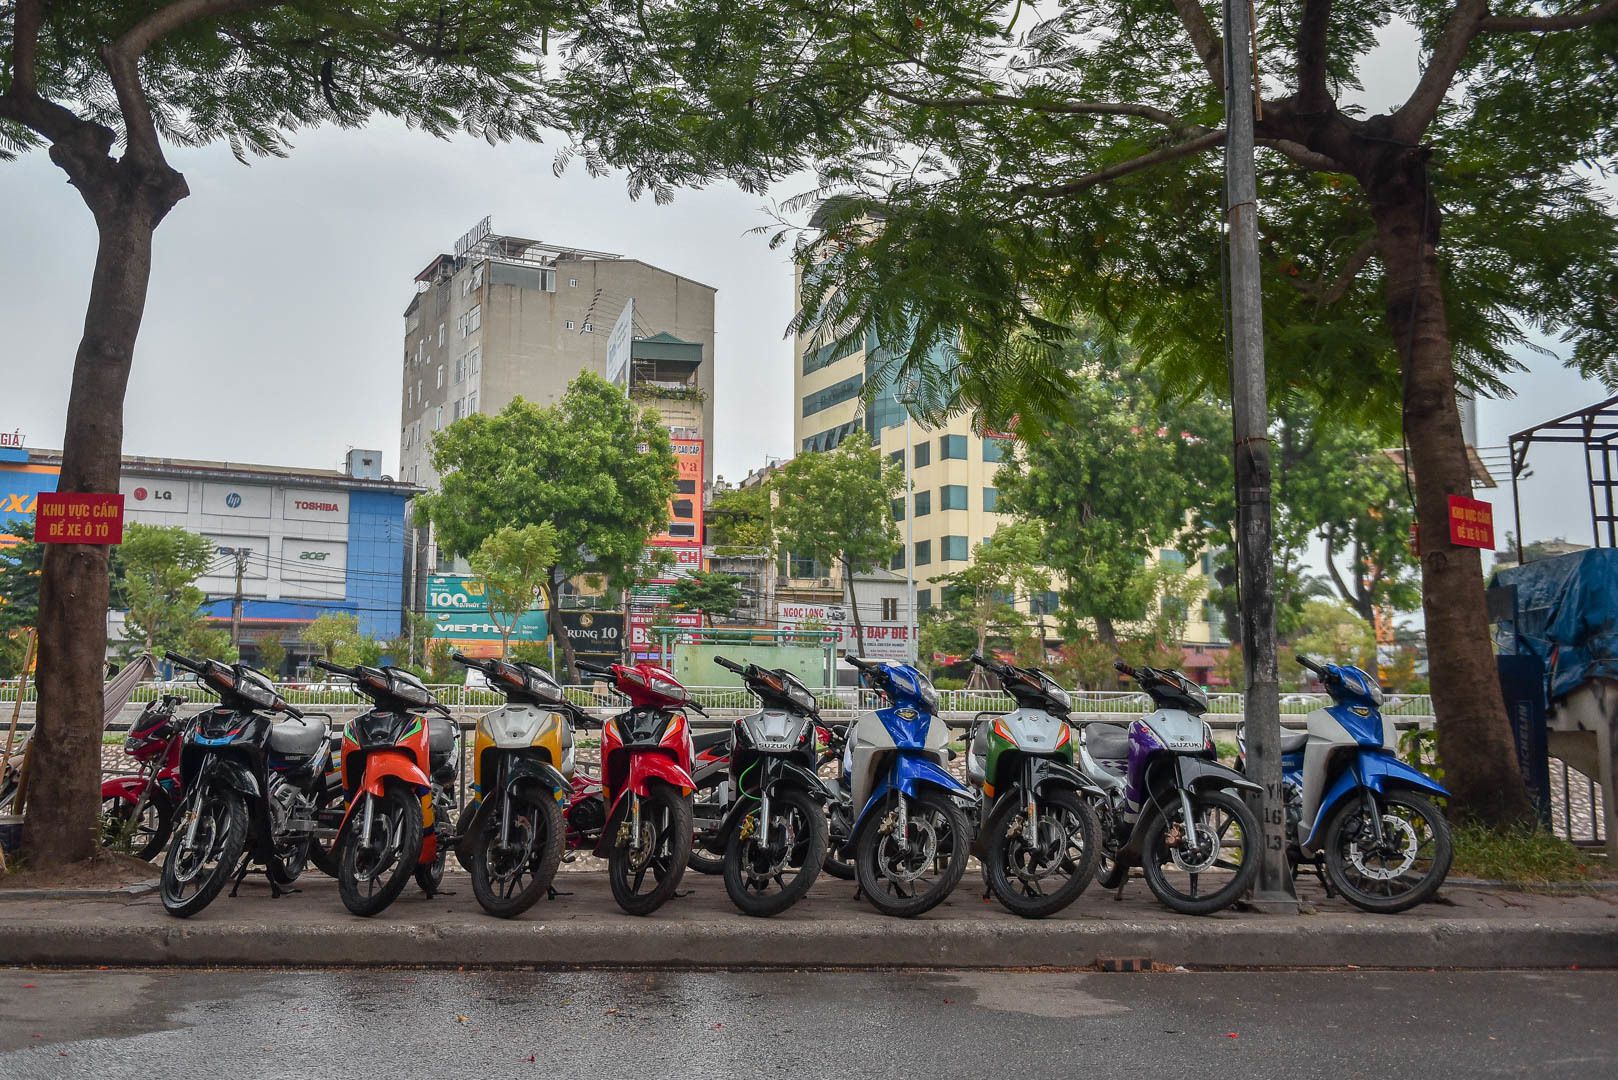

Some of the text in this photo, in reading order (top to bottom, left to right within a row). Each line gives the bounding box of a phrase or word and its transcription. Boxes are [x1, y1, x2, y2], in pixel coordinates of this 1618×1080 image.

[155, 490, 172, 500] LG
[226, 493, 241, 508] hp
[43, 503, 65, 516] KHU
[68, 504, 90, 519] VỰC
[93, 501, 118, 518] CẤM
[295, 501, 339, 512] TOSHIBA
[49, 519, 109, 537] ĐỂ XE Ô TÔ
[300, 551, 330, 561] acer
[431, 593, 467, 607] 100
[563, 626, 598, 640] RUNG
[602, 627, 617, 640] 10
[867, 626, 888, 641] ĐẠP
